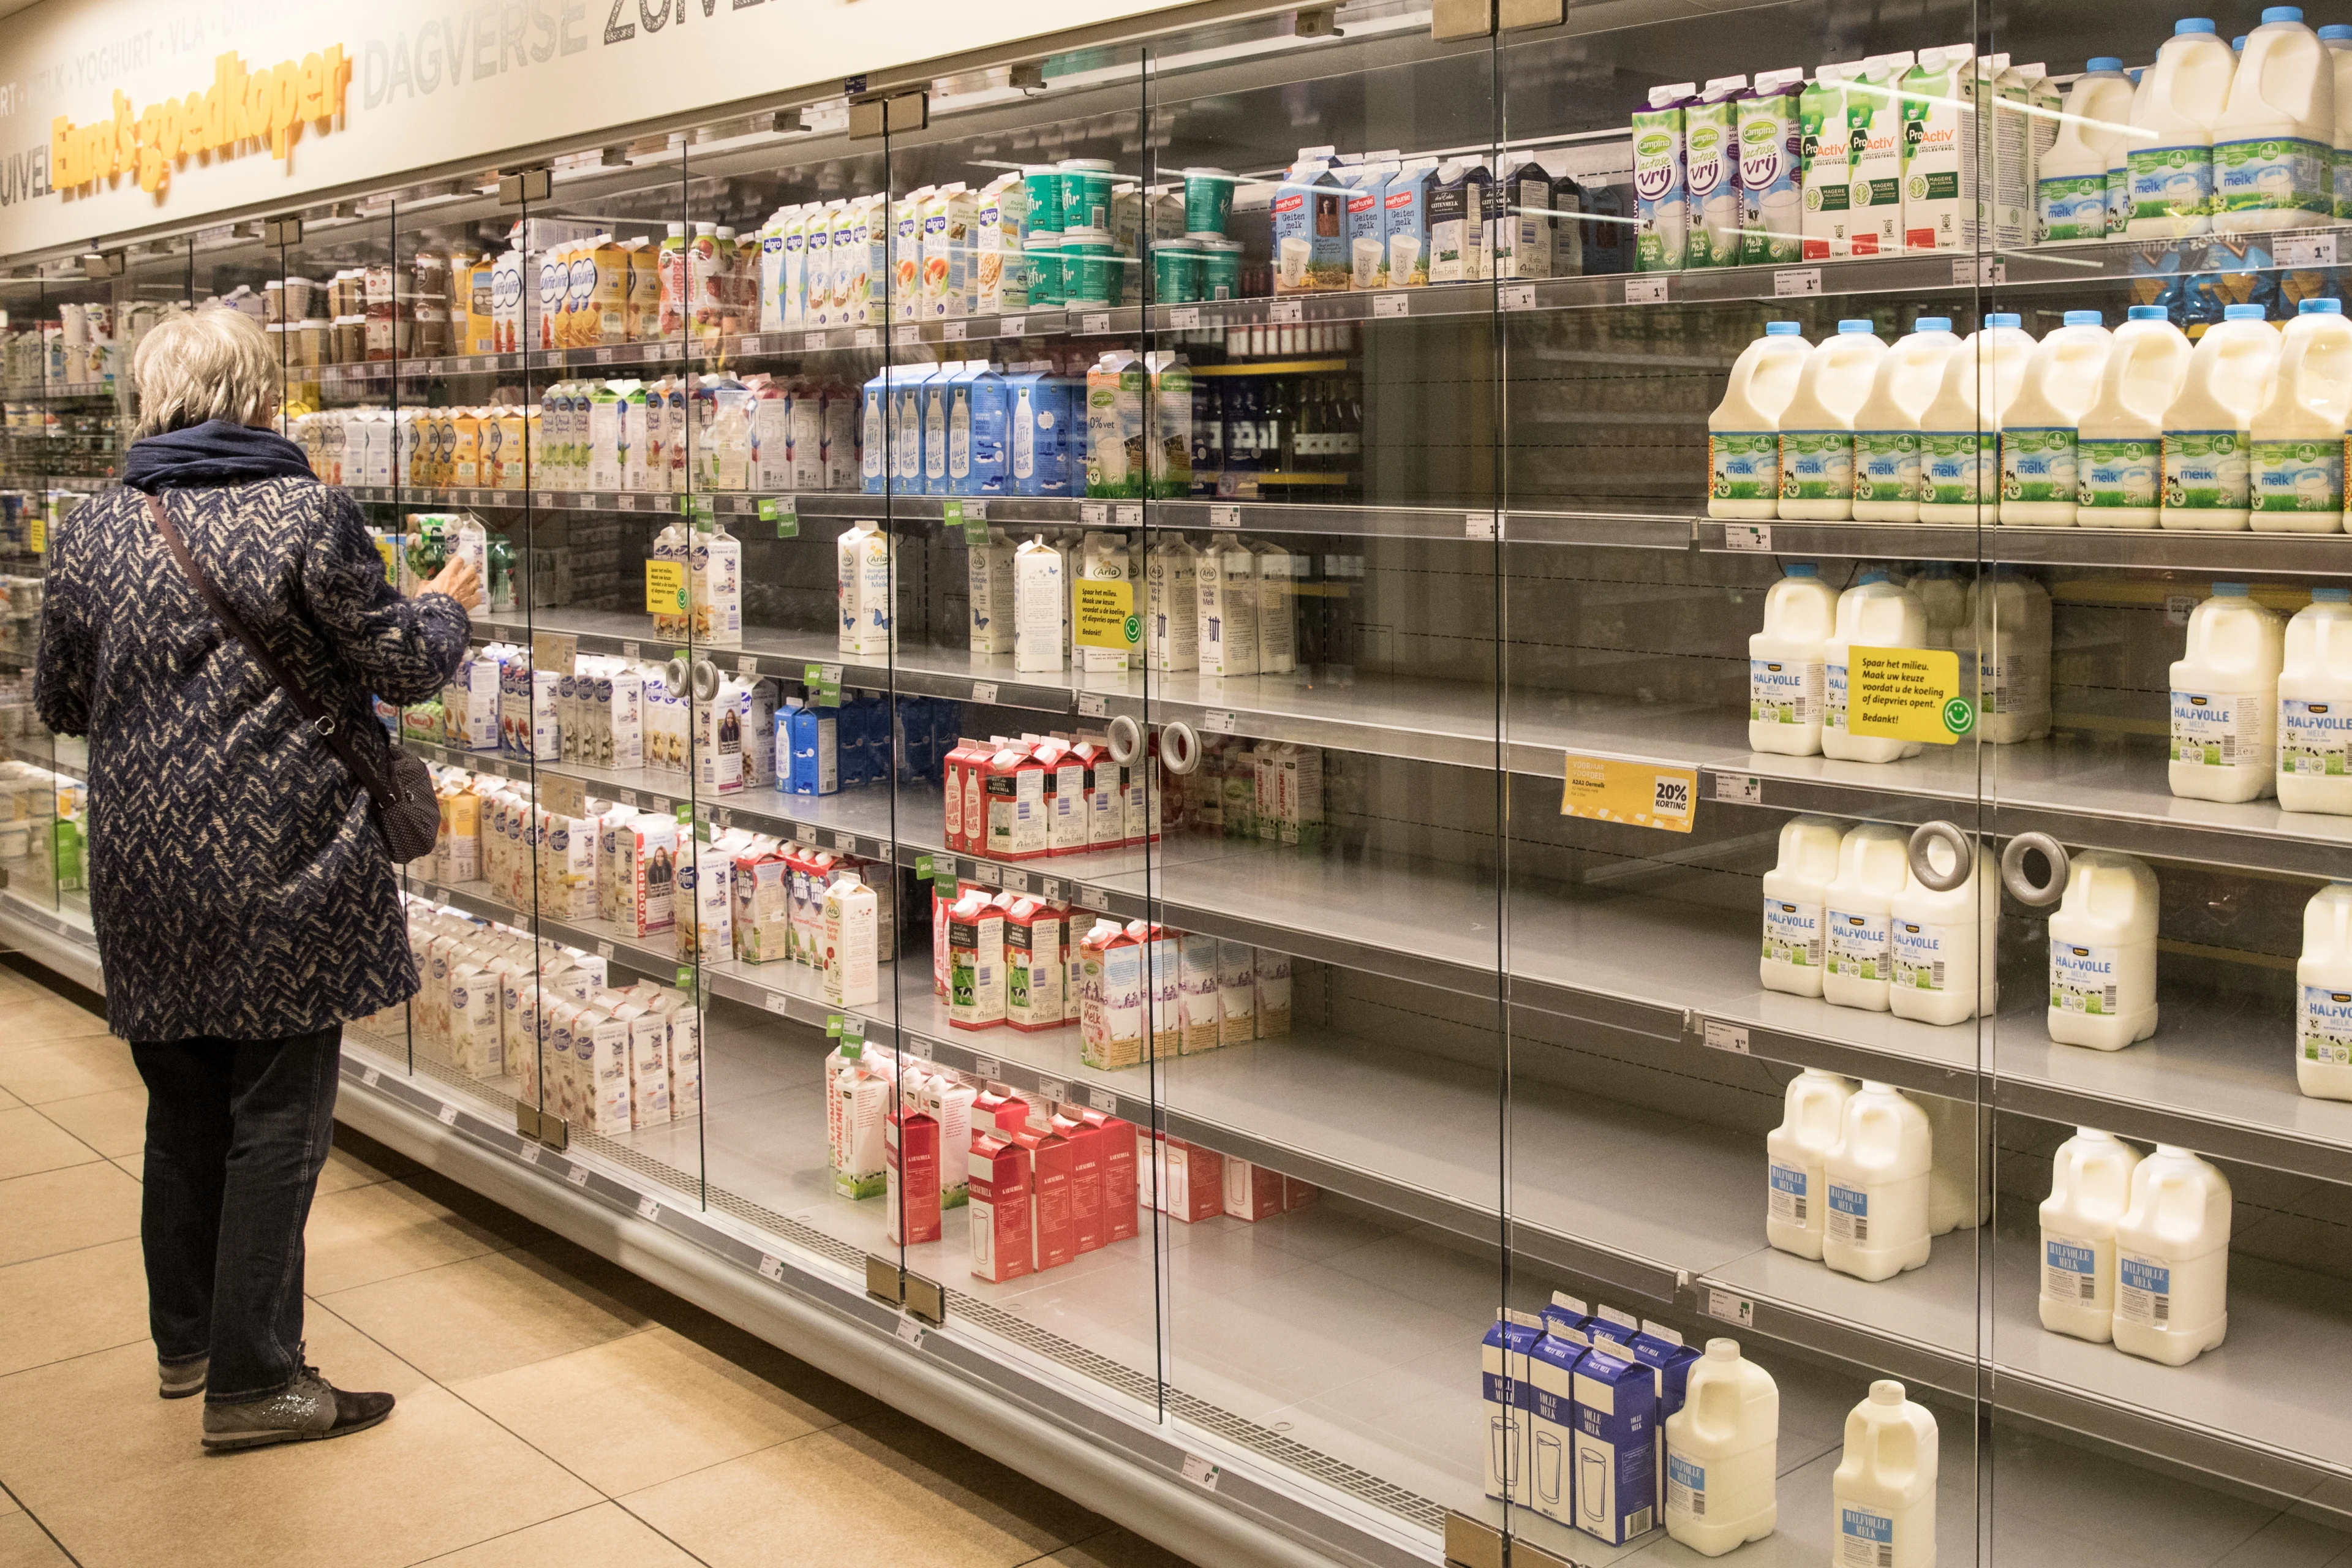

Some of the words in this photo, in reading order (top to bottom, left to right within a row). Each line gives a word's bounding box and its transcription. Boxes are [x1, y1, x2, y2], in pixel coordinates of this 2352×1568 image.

[77, 29, 153, 88] YOGHURT
[168, 12, 205, 55] VLA
[365, 0, 588, 110] DAGVERSE
[140, 42, 343, 192] goedkoper
[1743, 126, 1776, 137] Campina
[1910, 129, 1953, 143] ProActiv
[1691, 132, 1717, 143] Campina
[1638, 139, 1670, 149] Campina
[1854, 137, 1894, 150] ProActiv
[1743, 145, 1776, 159] lactose
[1806, 143, 1847, 157] ProActiv
[1638, 156, 1670, 170] lactose
[1691, 150, 1717, 165] lactose
[1691, 160, 1718, 181] vrij
[1744, 154, 1776, 176] vrij
[1638, 165, 1671, 186] vrij
[2225, 175, 2251, 186] melk
[2135, 182, 2160, 194] melk
[1276, 197, 1301, 209] melkunie
[1349, 198, 1373, 210] melkunie
[1385, 194, 1411, 206] melkunie
[981, 211, 996, 221] alpro
[2048, 208, 2070, 217] melk
[899, 222, 913, 233] alpro
[927, 219, 944, 229] alpro
[835, 233, 850, 241] alpro
[855, 230, 865, 238] alpro
[979, 230, 998, 243] HAVER
[766, 240, 781, 249] alpro
[788, 238, 802, 246] alpro
[1691, 242, 1705, 251] Melk
[1746, 237, 1763, 247] Melk
[1640, 246, 1657, 255] Melk
[1090, 417, 1102, 429] 0%
[1727, 464, 1752, 474] melk
[1796, 462, 1822, 473] melk
[1868, 464, 1894, 475] melk
[1932, 466, 1958, 477] melk
[763, 505, 775, 513] Bio
[1863, 658, 1884, 668] Spaar
[1887, 660, 1899, 668] het
[1902, 662, 1929, 671] milieu.
[809, 671, 820, 679] Bio
[1754, 673, 1801, 686] HALFVOLLE
[1863, 671, 1885, 679] Maak
[1901, 673, 1924, 682] keuze
[1863, 684, 1893, 692] voordat
[1914, 687, 1943, 699] koeling
[1863, 694, 1871, 704] of
[1873, 695, 1907, 706] diepvries
[1910, 700, 1936, 709] opent.
[1863, 713, 1898, 724] Bedankt!
[2174, 707, 2230, 722] HALFVOLLE
[2287, 716, 2352, 730] HALFVOLLE
[1573, 761, 1604, 771] VOORJAAR
[1573, 770, 1605, 780] VOORDEEL
[1657, 783, 1687, 801] 20%
[1656, 799, 1686, 810] KORTING
[1768, 911, 1815, 929] HALFVOLLE
[1833, 925, 1884, 941] HALFVOLLE
[1894, 932, 1939, 949] HALFVOLLE
[2056, 955, 2111, 974] HALFVOLLE
[1085, 1001, 1099, 1011] Karne
[1084, 1011, 1101, 1025] Melk
[830, 1022, 842, 1030] Bio
[1110, 1152, 1129, 1160] KARNEMELK
[1076, 1162, 1095, 1171] KARNEMELK
[1044, 1175, 1065, 1184] KARNEMELK
[970, 1183, 992, 1197] KARNEMELK
[1003, 1185, 1023, 1194] KARNEMELK
[1540, 1392, 1557, 1408] VOLLE
[1584, 1408, 1601, 1425] VOLLE
[1630, 1414, 1642, 1424] VOLLE
